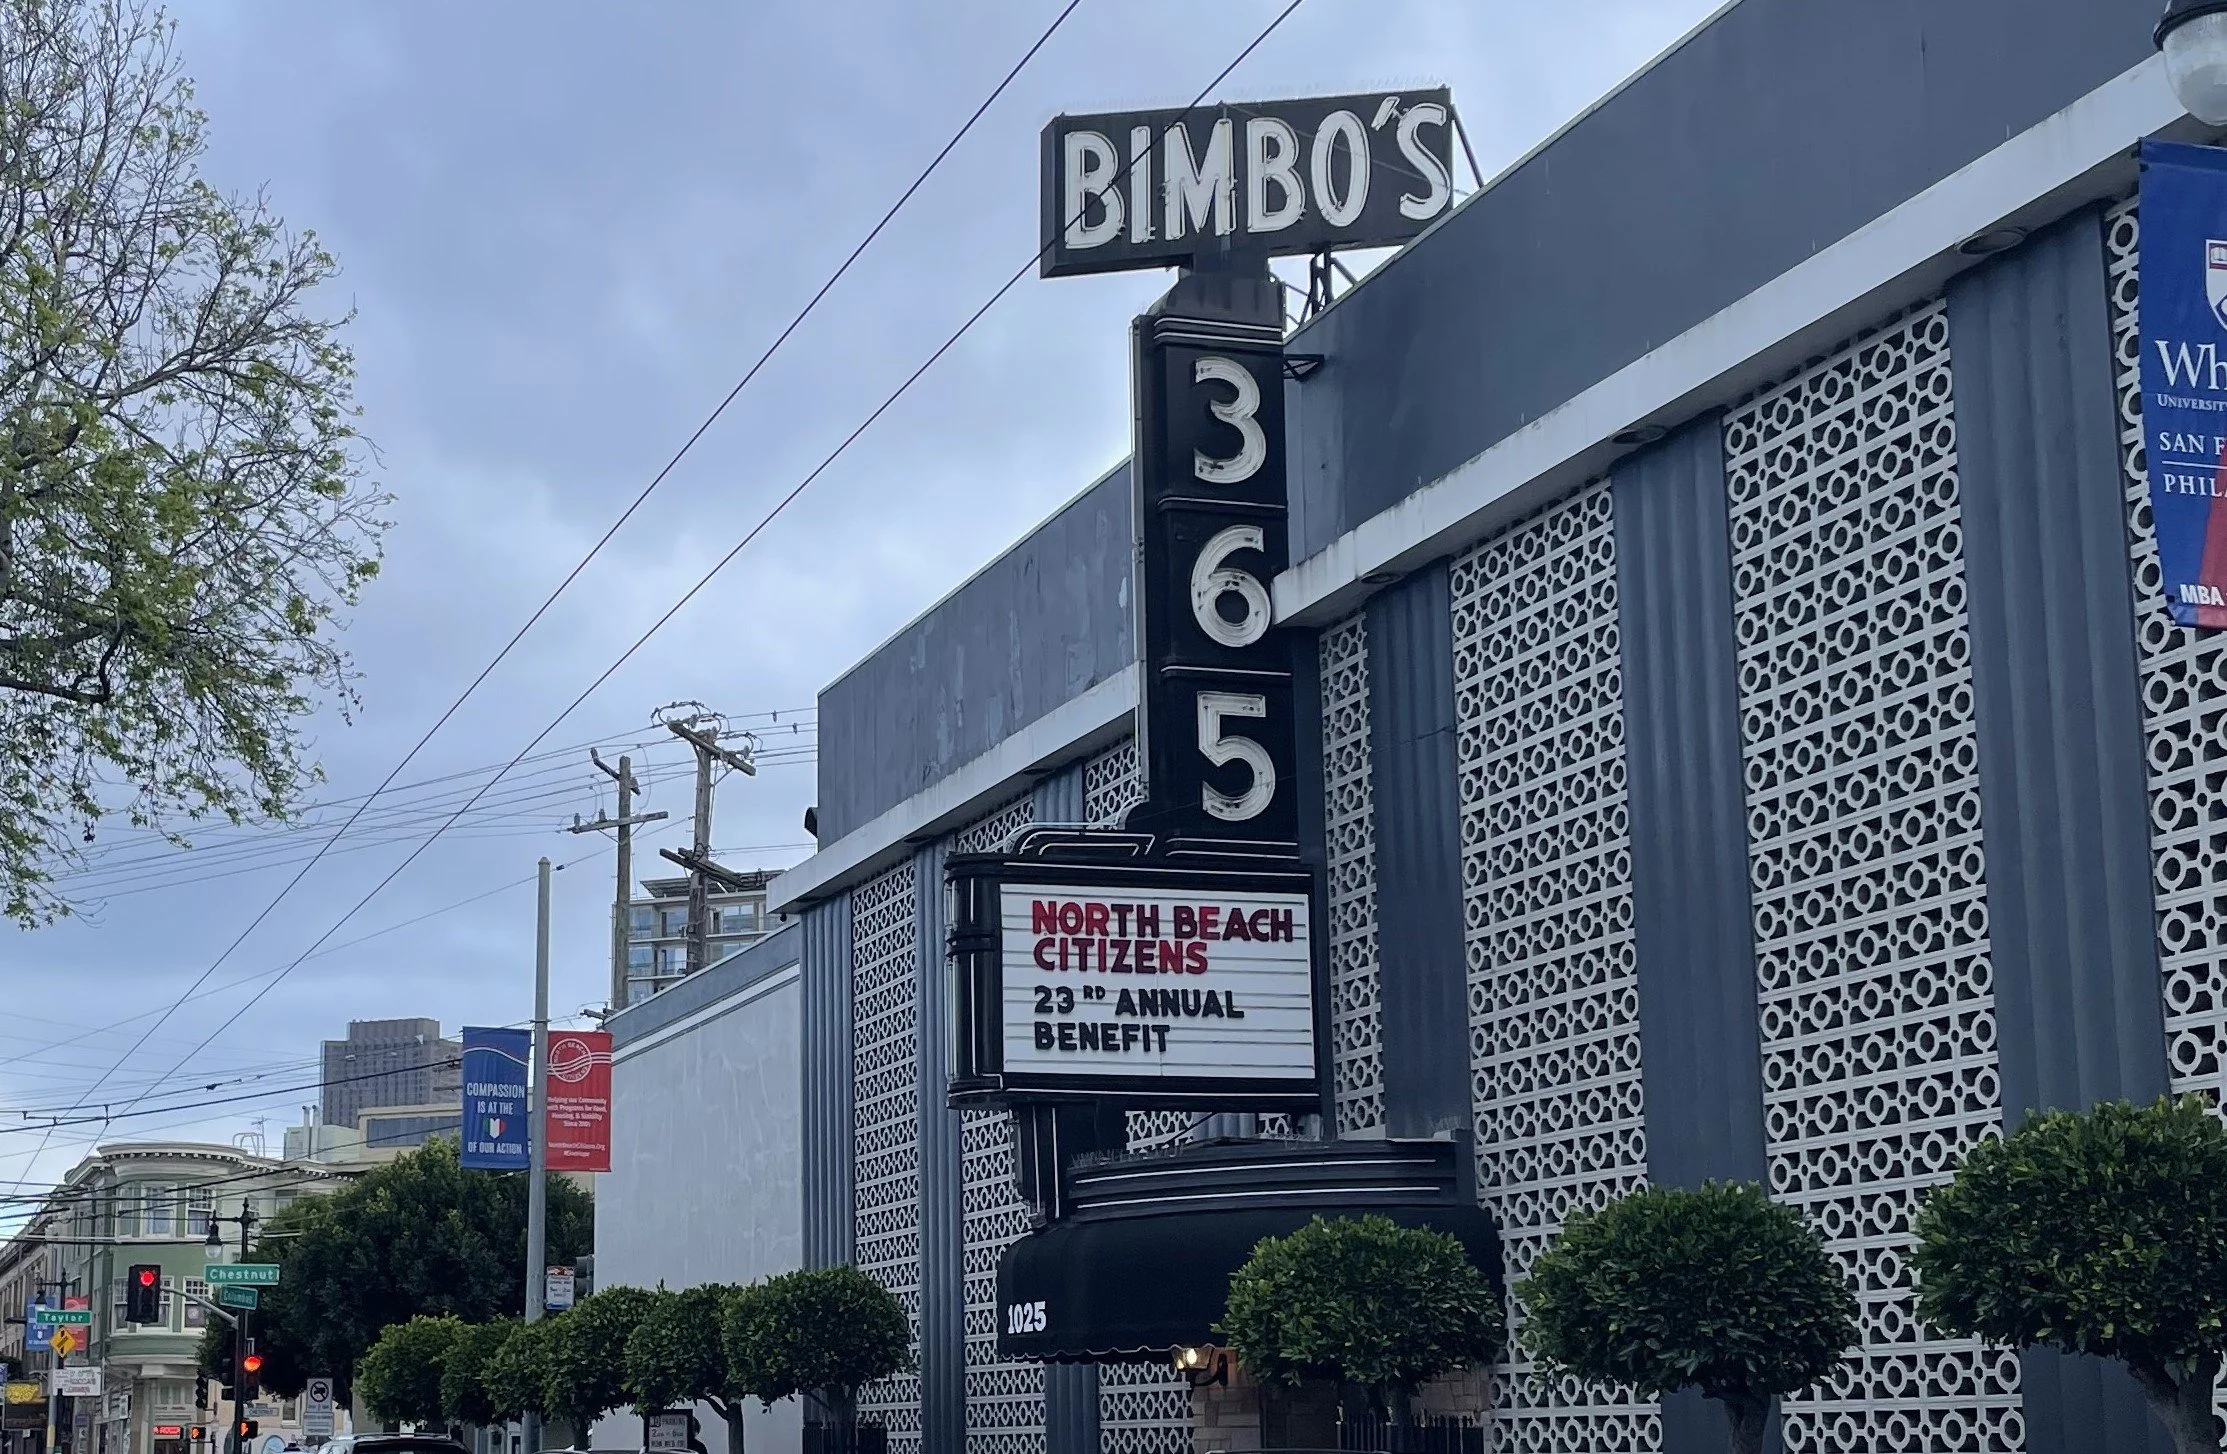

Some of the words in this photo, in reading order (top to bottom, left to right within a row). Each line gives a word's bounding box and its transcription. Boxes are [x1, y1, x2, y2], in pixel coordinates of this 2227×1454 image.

[1064, 96, 1451, 250] BIMBO'S
[2154, 340, 2227, 390] Wh
[2159, 432, 2206, 454] SAN
[2180, 584, 2225, 606] MBA
[1032, 900, 1160, 938] NORTH
[1173, 905, 1294, 942] BEACH
[1033, 937, 1208, 974] CITIZENS
[1034, 985, 1075, 1014] 23
[1083, 985, 1105, 1000] RD
[1115, 988, 1245, 1018] ANNUAL
[1034, 1021, 1170, 1052] BENEFIT
[466, 1082, 525, 1098] COMPASSION
[477, 1101, 486, 1114] IS
[488, 1101, 497, 1114] AT
[499, 1102, 514, 1115] THE
[468, 1141, 477, 1153] OF
[479, 1141, 494, 1153] OUR
[496, 1143, 522, 1154] ACTION
[209, 1268, 274, 1280] Chestnut
[44, 1313, 83, 1323] Taylor
[1008, 1301, 1047, 1334] 1025
